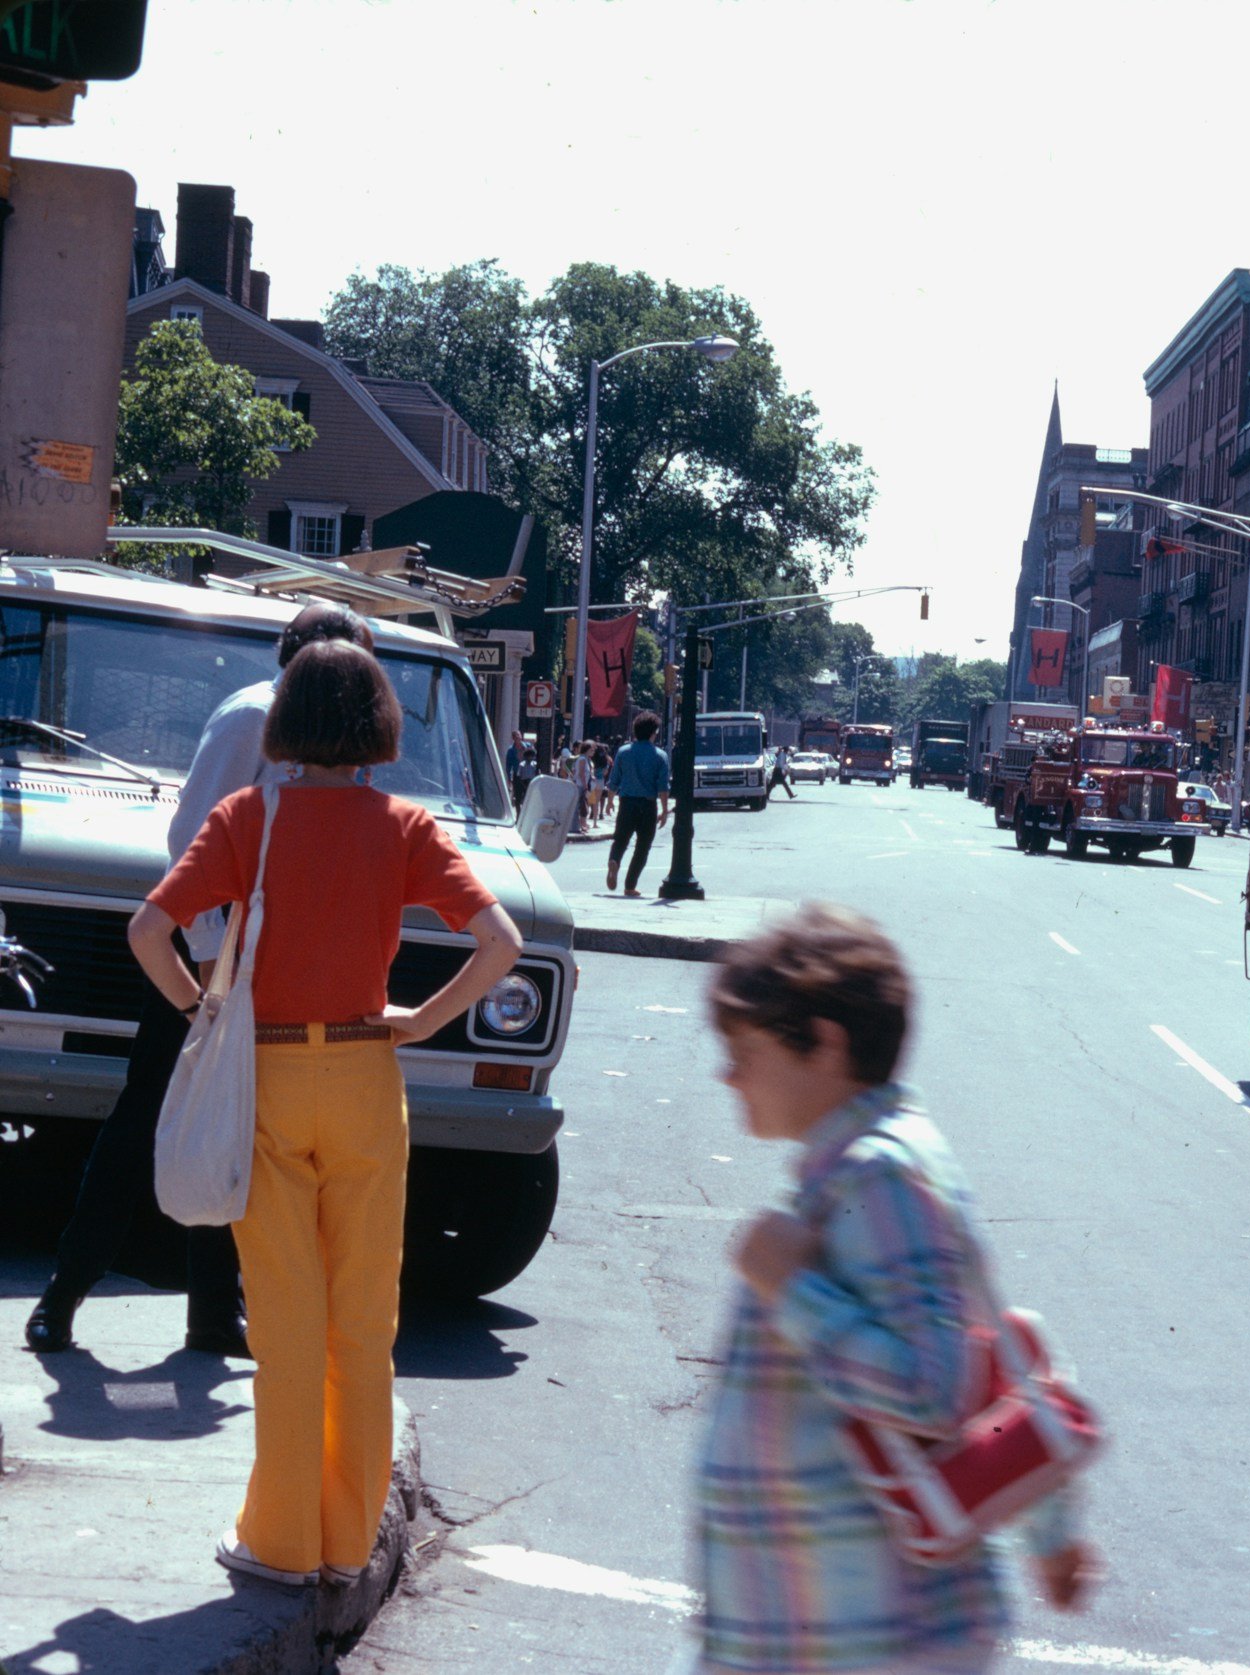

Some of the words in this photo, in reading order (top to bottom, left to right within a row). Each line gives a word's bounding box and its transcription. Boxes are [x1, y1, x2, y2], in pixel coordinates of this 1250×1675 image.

[1036, 648, 1059, 669] H
[603, 648, 628, 689] H
[534, 686, 545, 704] F
[1013, 716, 1074, 730] ANDARD
